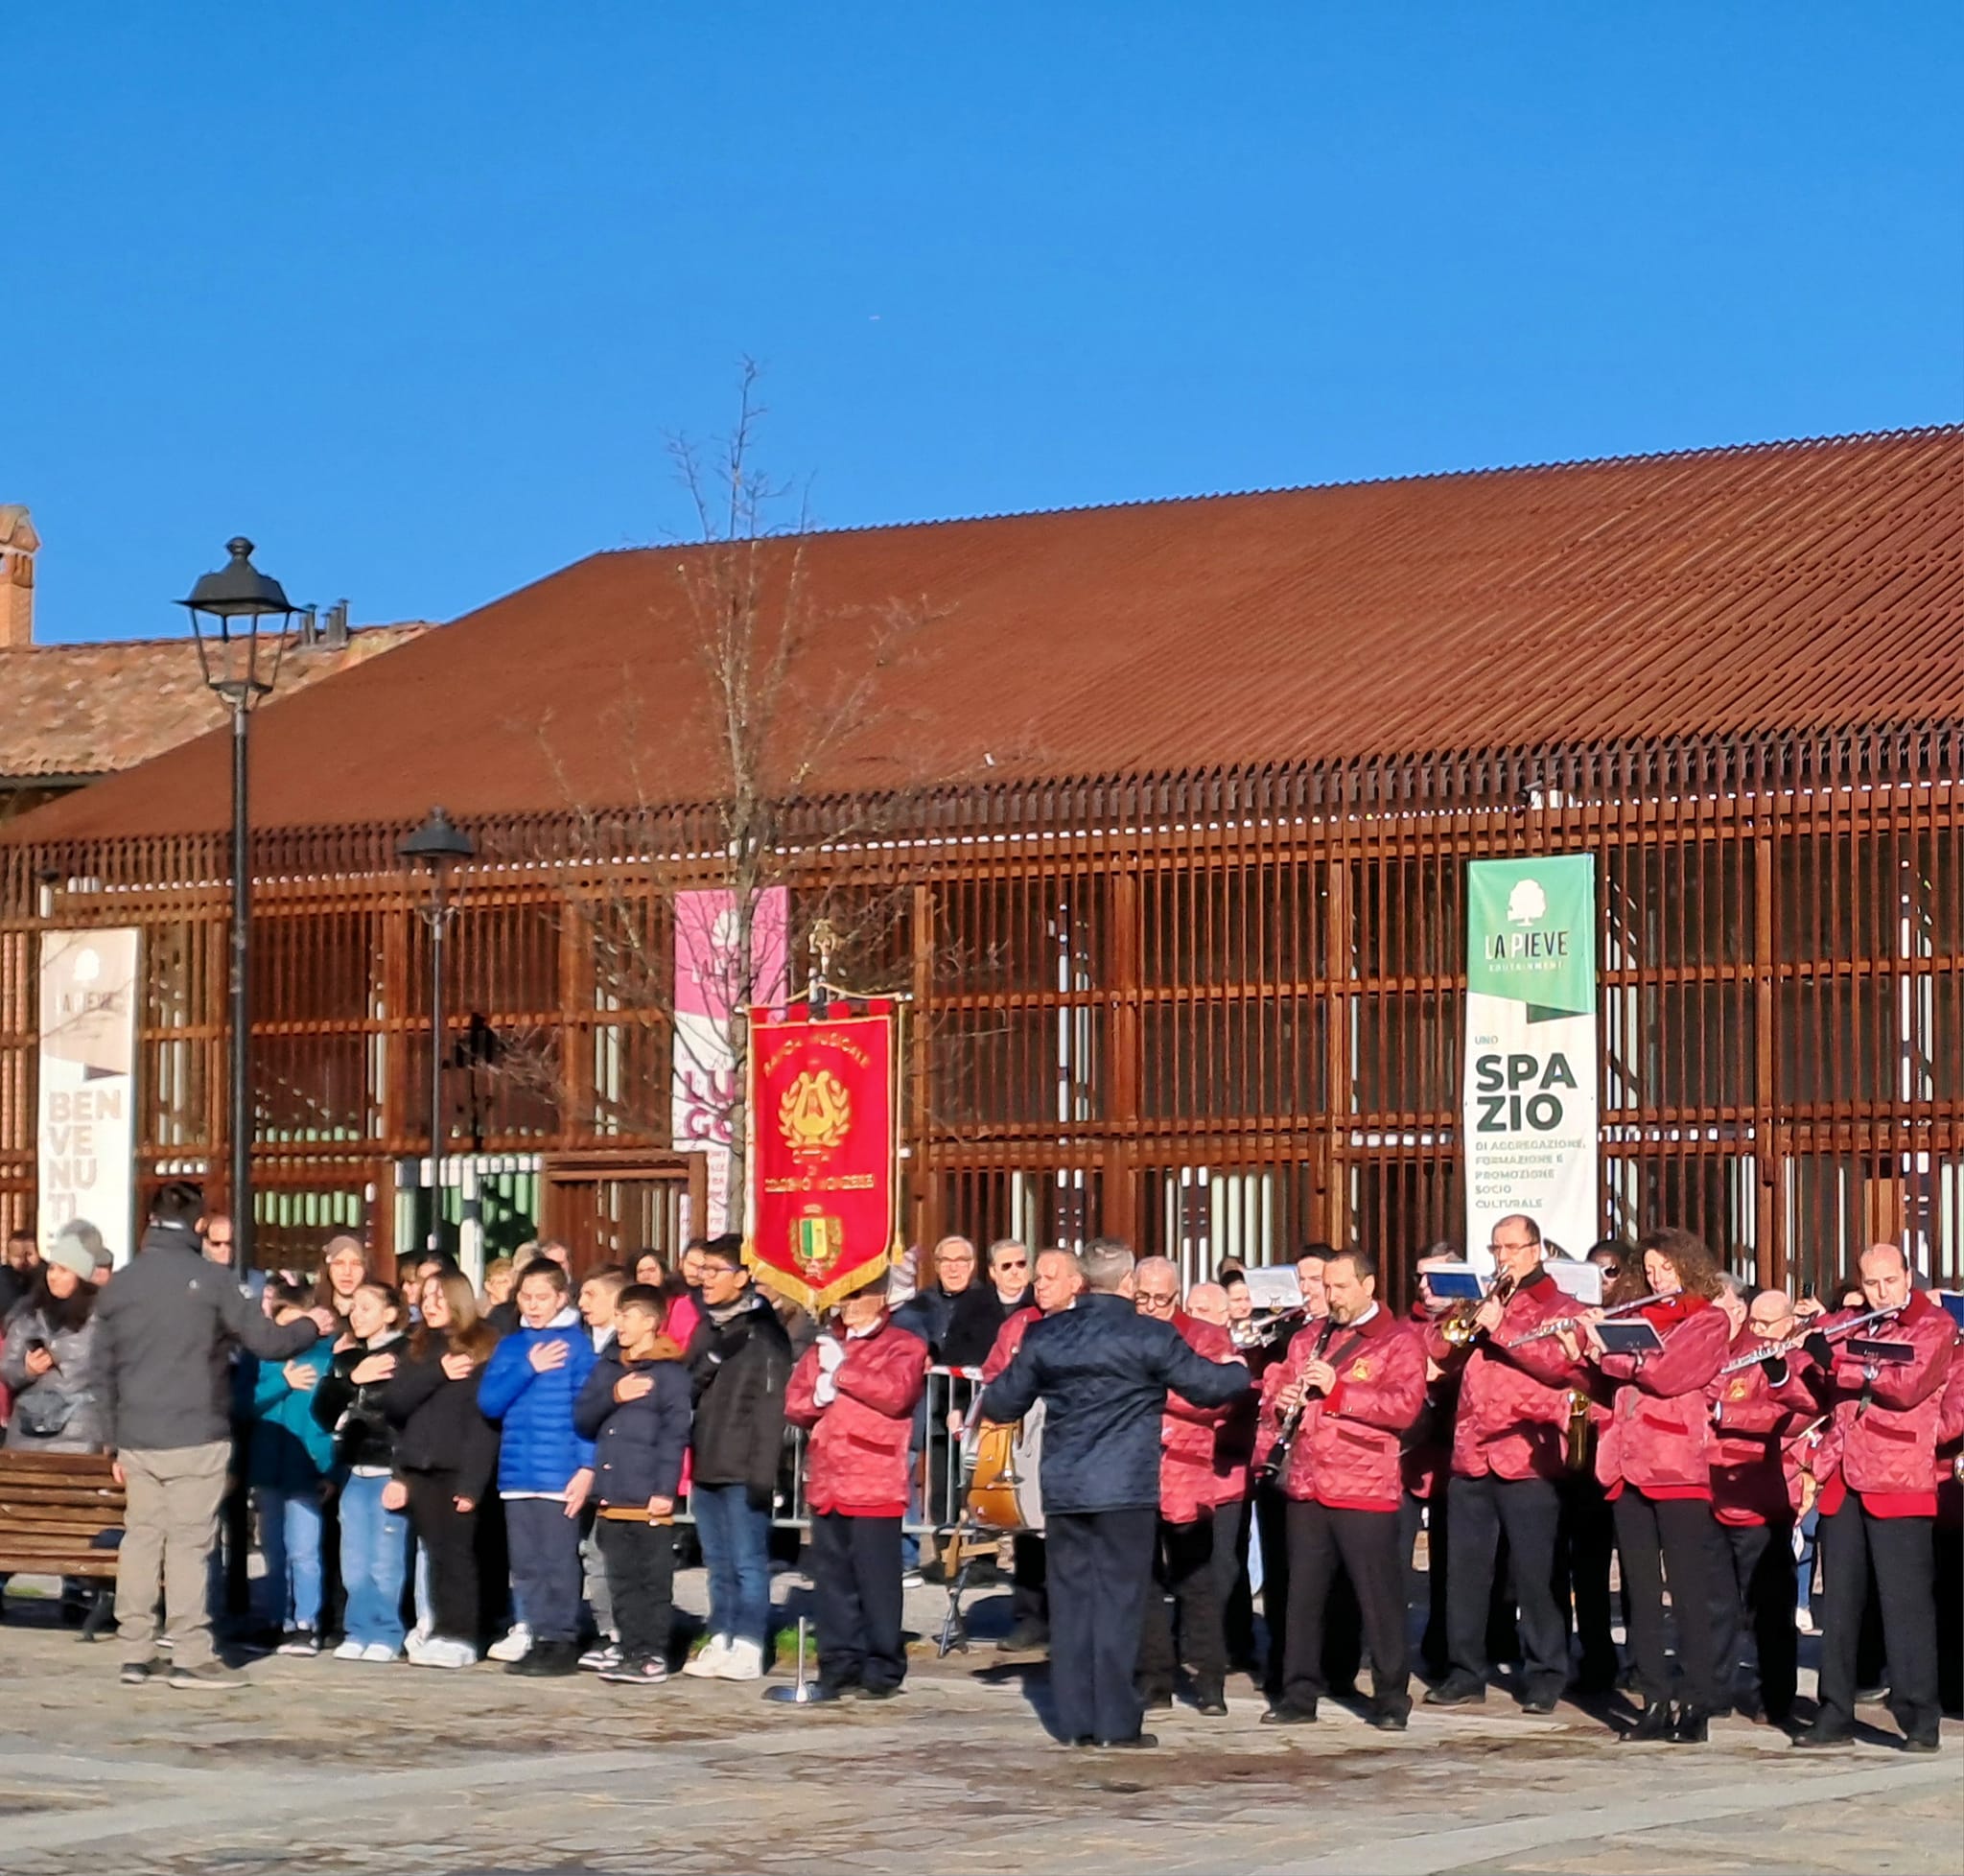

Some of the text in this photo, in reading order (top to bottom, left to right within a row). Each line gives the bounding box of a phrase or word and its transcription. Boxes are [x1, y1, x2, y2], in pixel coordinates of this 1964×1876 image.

[1485, 930, 1569, 960] LA PIEVE
[1475, 1035, 1499, 1045] UNO
[1475, 1052, 1578, 1092] SPA
[48, 1089, 122, 1120] BEN
[1476, 1093, 1564, 1132] ZIO
[47, 1124, 93, 1156] VE
[1475, 1141, 1487, 1151] DI
[47, 1158, 98, 1190] NU
[1475, 1153, 1563, 1165] FORMAZIONE E
[1475, 1168, 1555, 1180] PROMOZIONE
[1475, 1184, 1512, 1195] SOCIO
[1475, 1198, 1543, 1209] CULTURALE
[47, 1192, 77, 1223] TI
